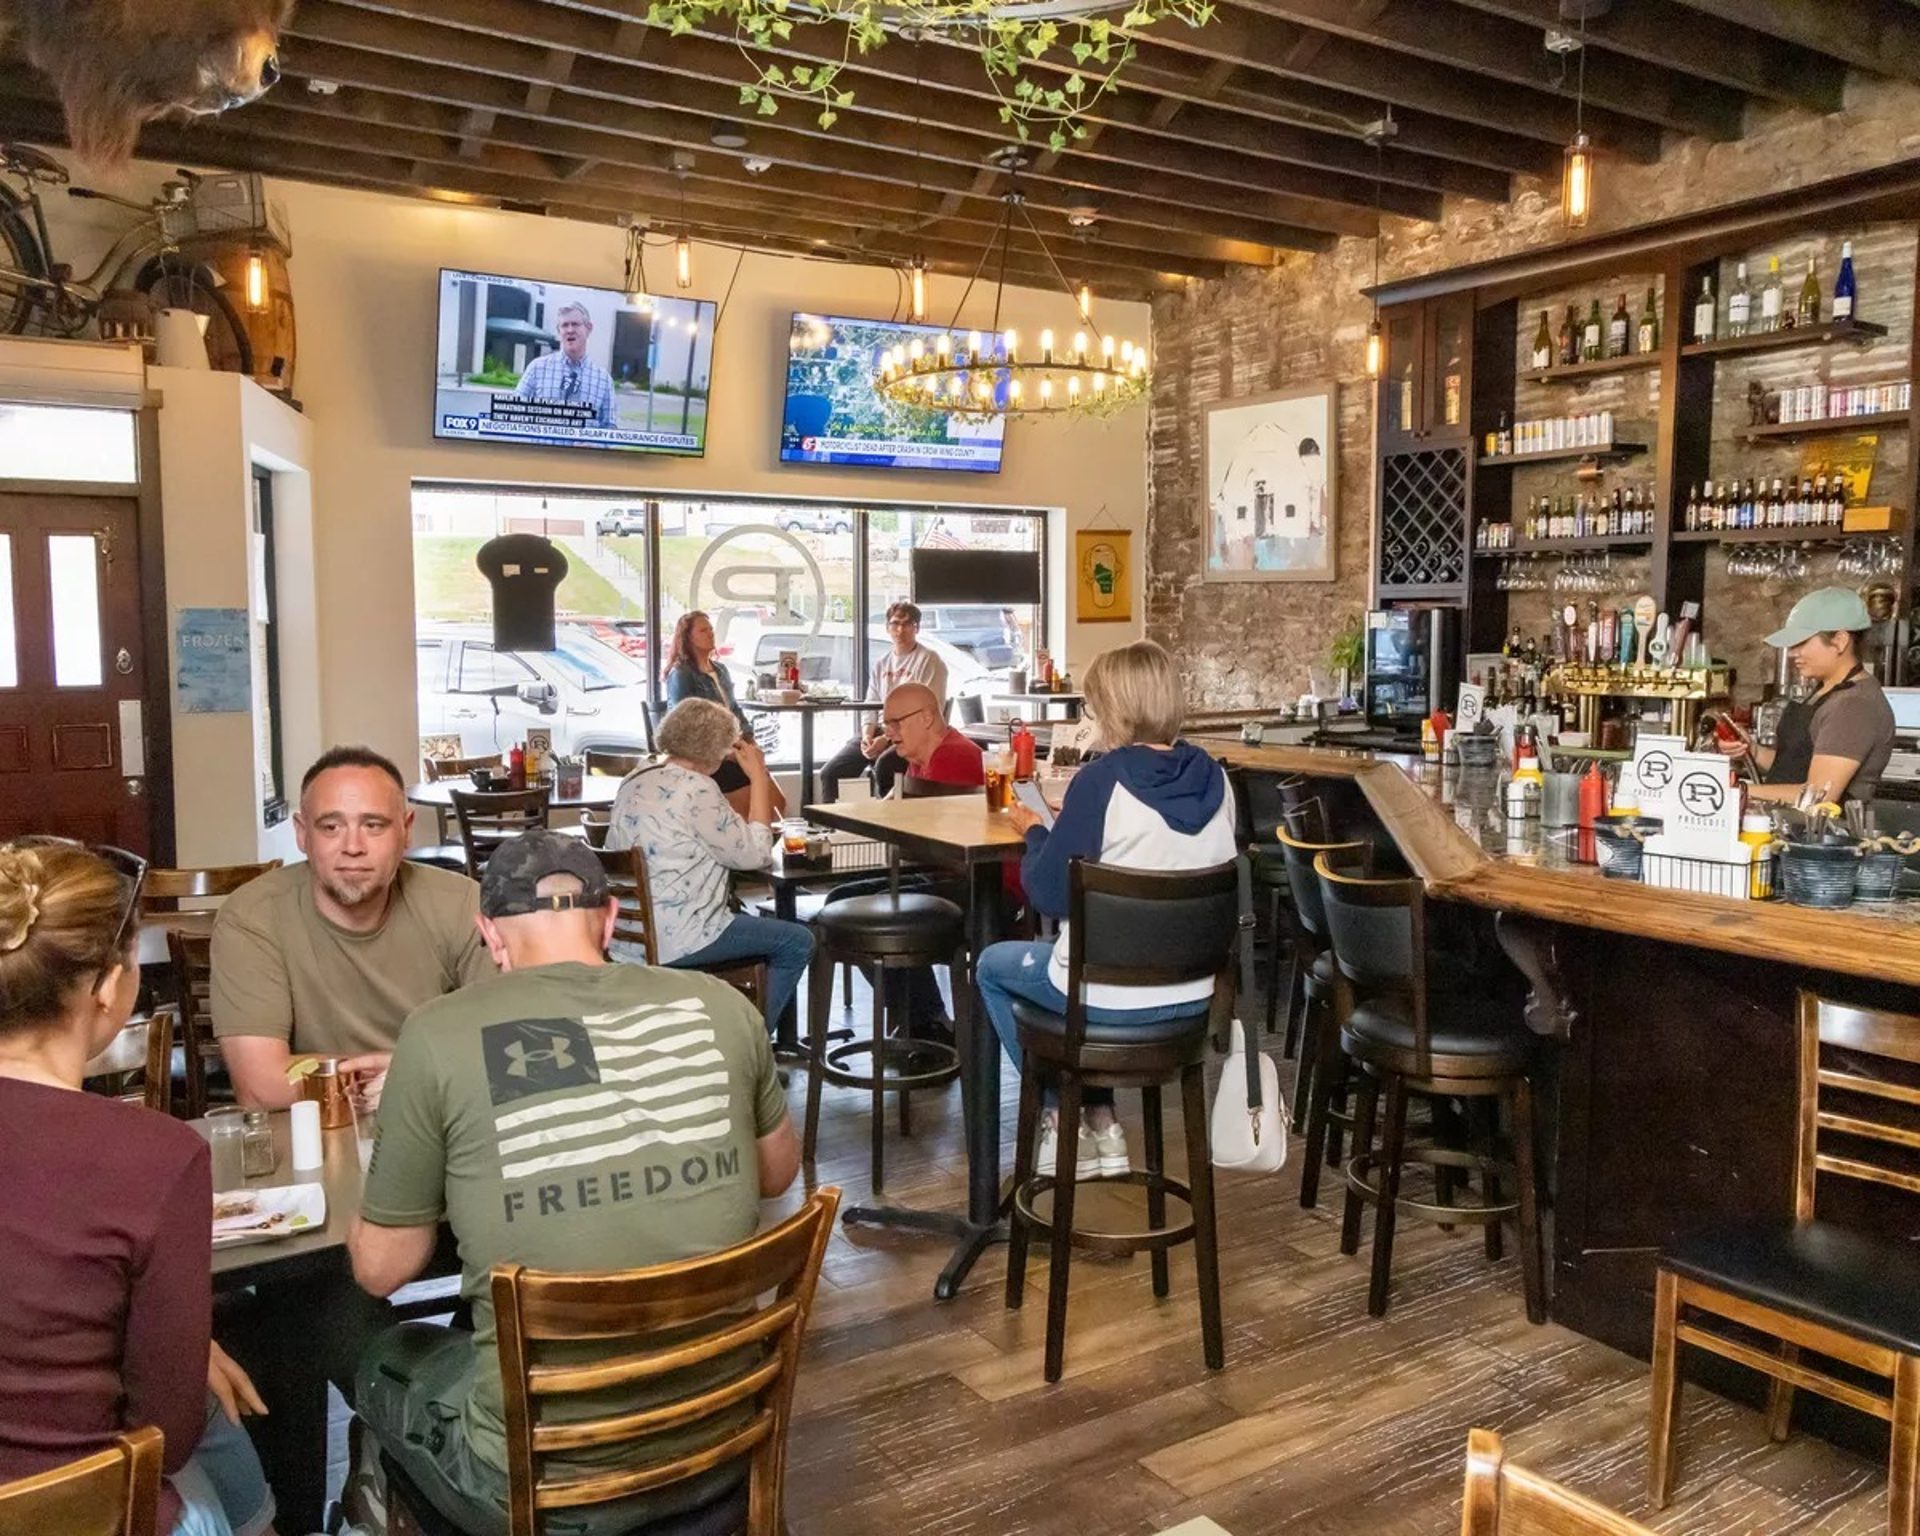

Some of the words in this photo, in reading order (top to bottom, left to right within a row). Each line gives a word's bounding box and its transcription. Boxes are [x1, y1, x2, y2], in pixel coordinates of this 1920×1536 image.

[493, 411, 509, 420] THEY
[510, 413, 535, 422] HAVEN'T
[527, 405, 553, 415] SESSION
[563, 408, 576, 417] MAY
[445, 416, 468, 429] FOX
[468, 418, 477, 430] 9
[482, 421, 540, 434] NEGOTIATIONS
[579, 430, 608, 440] SALARY
[616, 433, 658, 443] INSURANCE
[661, 436, 695, 445] DISPUTES
[182, 635, 245, 648] FROZEN
[504, 1147, 740, 1223] FREEDOM
